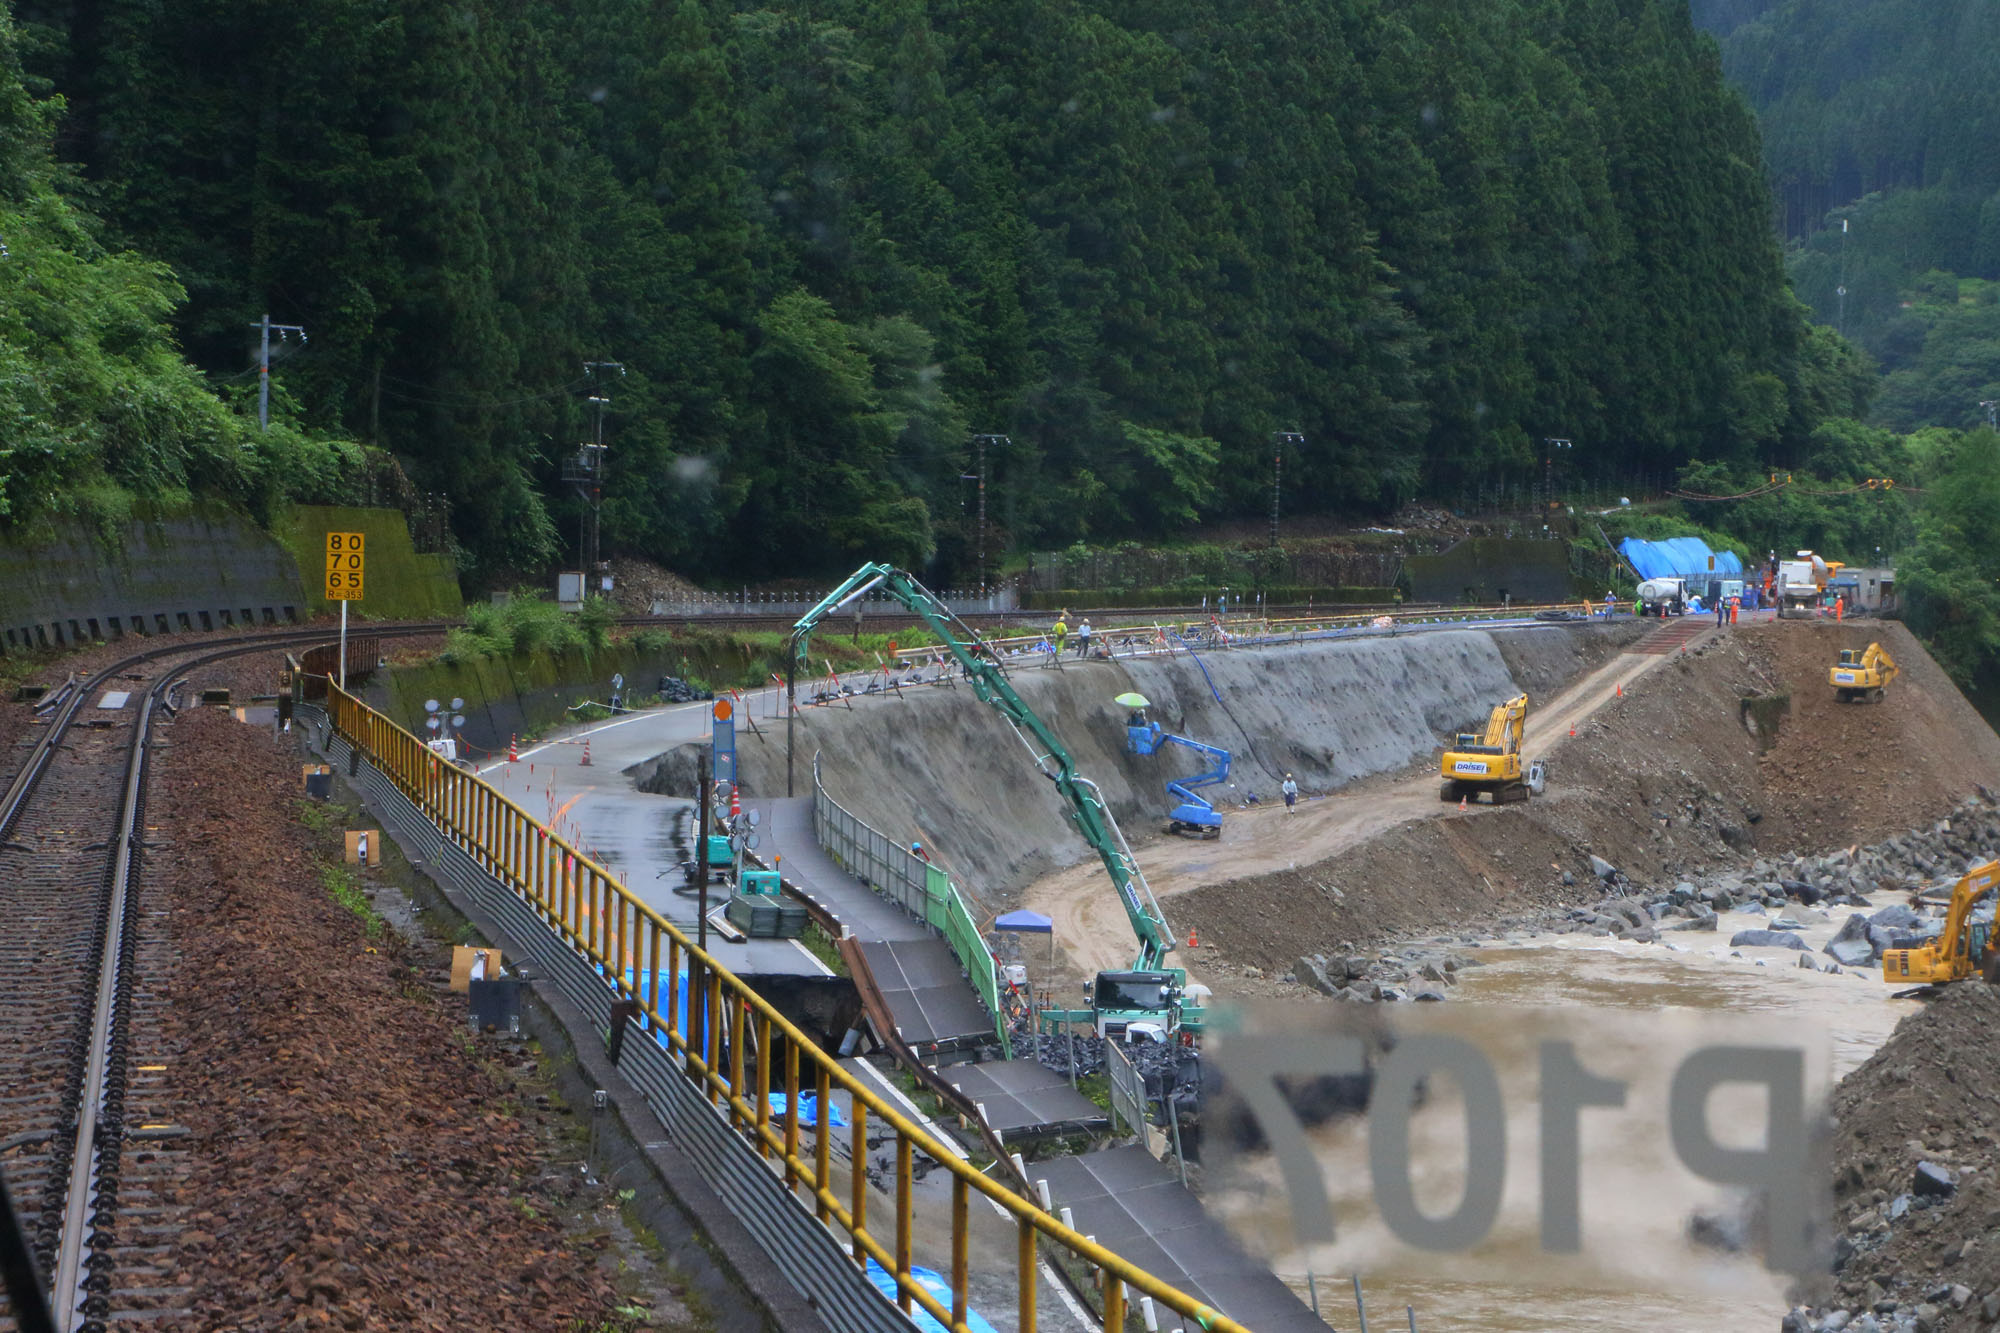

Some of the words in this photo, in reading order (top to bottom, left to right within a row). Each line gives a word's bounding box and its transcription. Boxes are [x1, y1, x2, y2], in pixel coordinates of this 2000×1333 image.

[331, 535, 361, 550] 80
[330, 553, 361, 569] 70
[330, 572, 360, 588] 65
